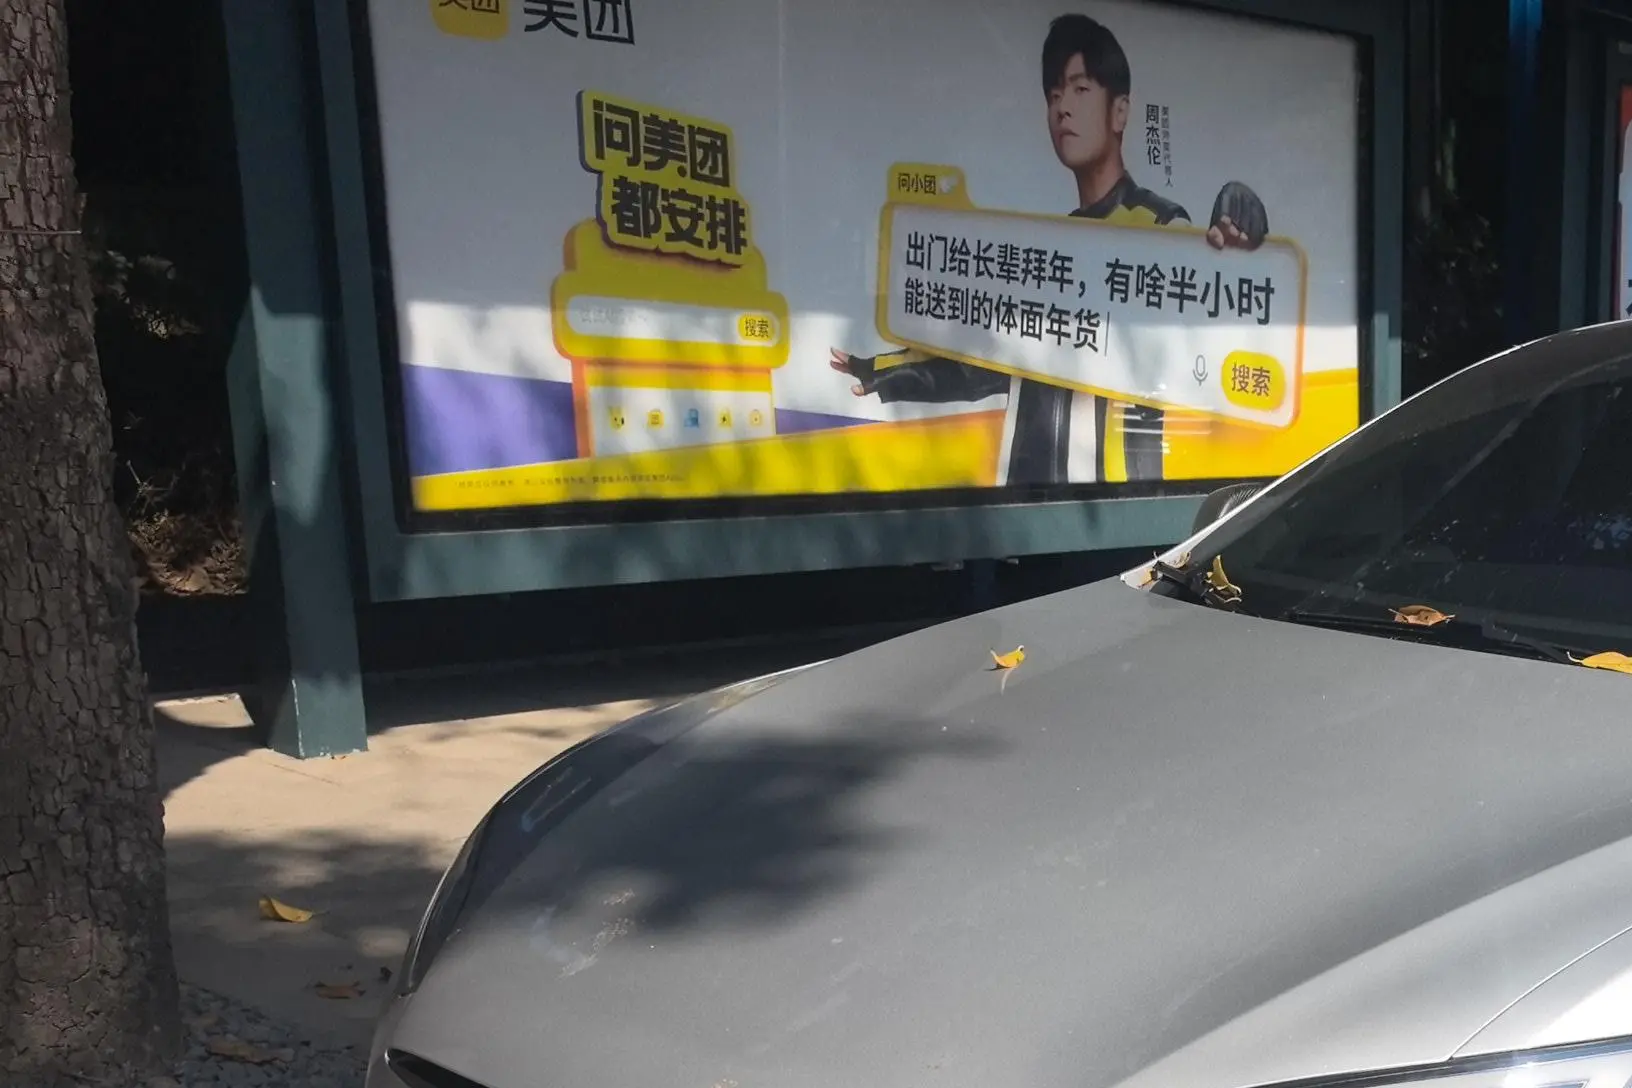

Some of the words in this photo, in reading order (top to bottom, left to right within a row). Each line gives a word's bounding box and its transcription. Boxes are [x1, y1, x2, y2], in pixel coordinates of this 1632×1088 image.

[593, 98, 731, 188] 问美团
[1145, 104, 1161, 165] 周杰伦
[897, 172, 937, 195] 问小团
[610, 175, 748, 256] 都安排
[744, 317, 770, 338] 搜索
[903, 276, 1100, 353] 能送到的体面年货
[1230, 361, 1271, 397] 搜索
